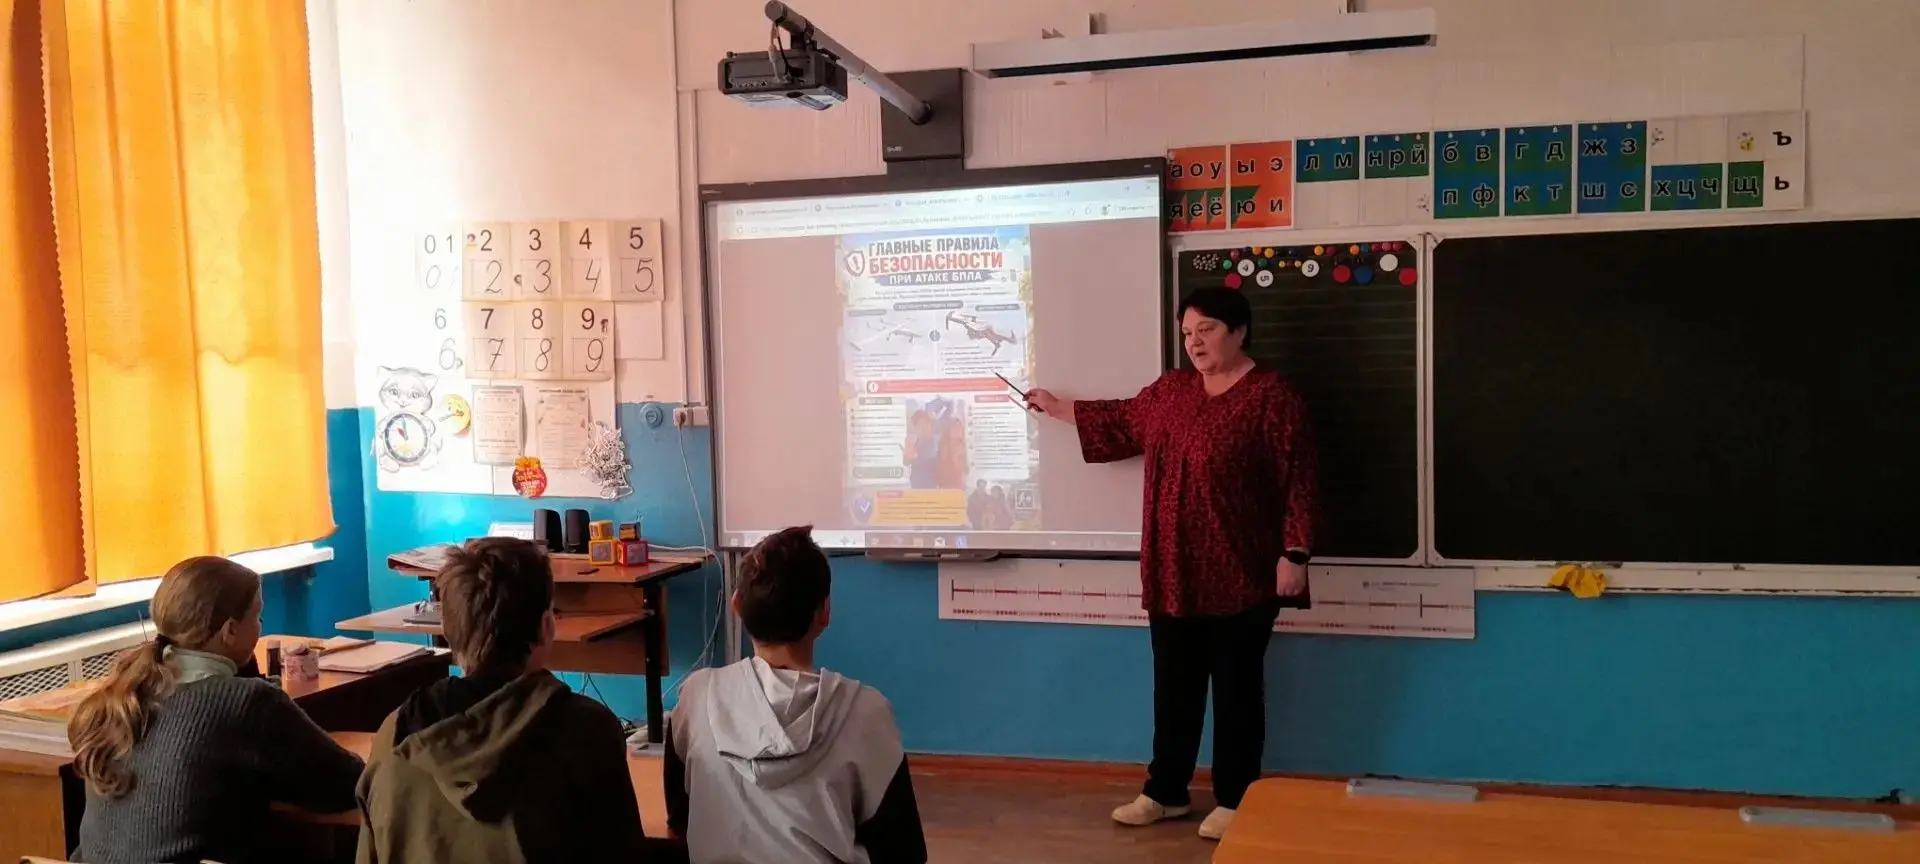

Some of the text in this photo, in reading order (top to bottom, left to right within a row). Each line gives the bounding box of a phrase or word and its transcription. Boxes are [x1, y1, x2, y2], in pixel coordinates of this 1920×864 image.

[480, 229, 493, 251] 2
[529, 228, 542, 251] 3
[578, 227, 593, 250] 4
[629, 227, 644, 250] 5
[868, 236, 999, 257] ГЛАВНЫЕ ПРАВИЛА
[868, 251, 1003, 275] БЕЗОПАСНОСТИ
[485, 259, 502, 293] 2
[534, 259, 551, 293] 3
[585, 258, 601, 292] 4
[634, 258, 653, 292] 5
[889, 271, 983, 285] ПРИ АТАКЕ БПЛА
[481, 308, 494, 330] 7
[531, 308, 544, 330] 8
[581, 307, 595, 330] 9
[535, 338, 552, 371] 8
[585, 338, 603, 372] 9
